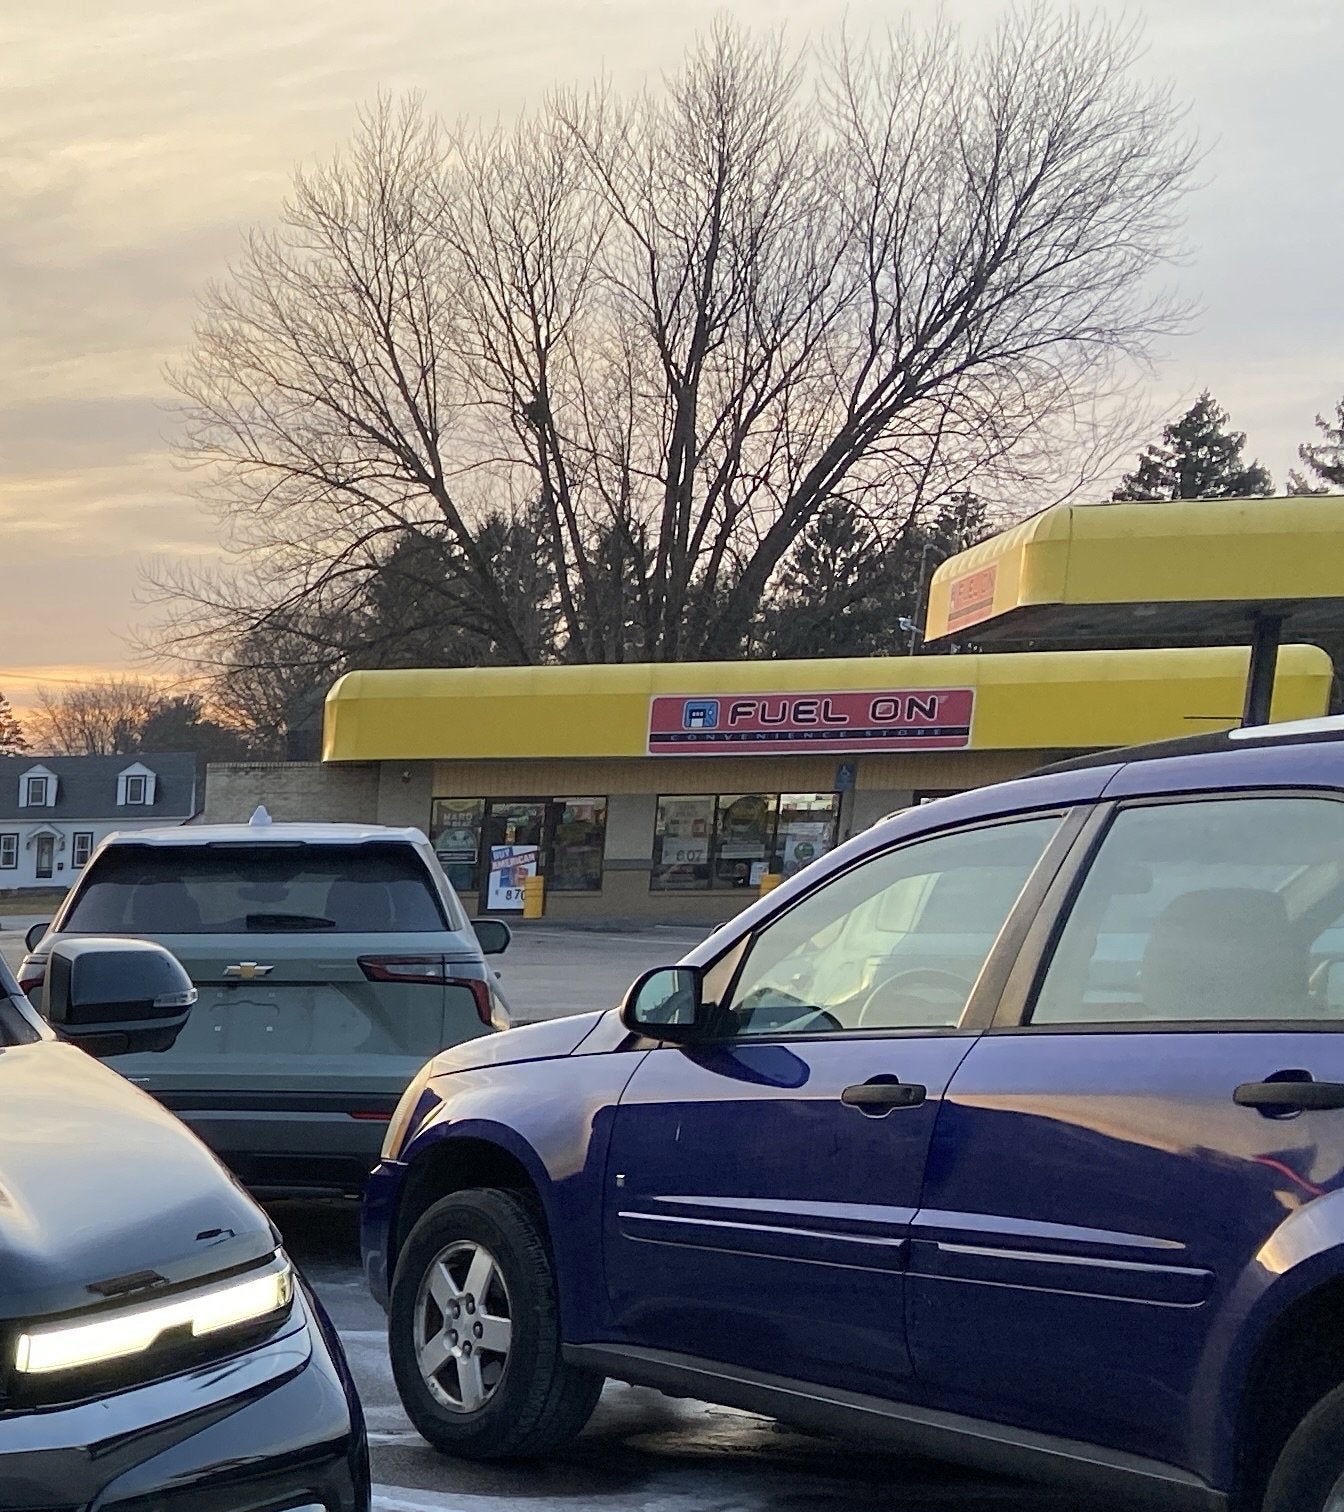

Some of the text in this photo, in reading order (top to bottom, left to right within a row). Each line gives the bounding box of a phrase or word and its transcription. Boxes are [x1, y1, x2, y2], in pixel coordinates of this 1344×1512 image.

[728, 695, 938, 726] FUEL ON
[670, 729, 941, 741] CONVENIENCE STORE
[492, 852, 536, 870] AMERICAN
